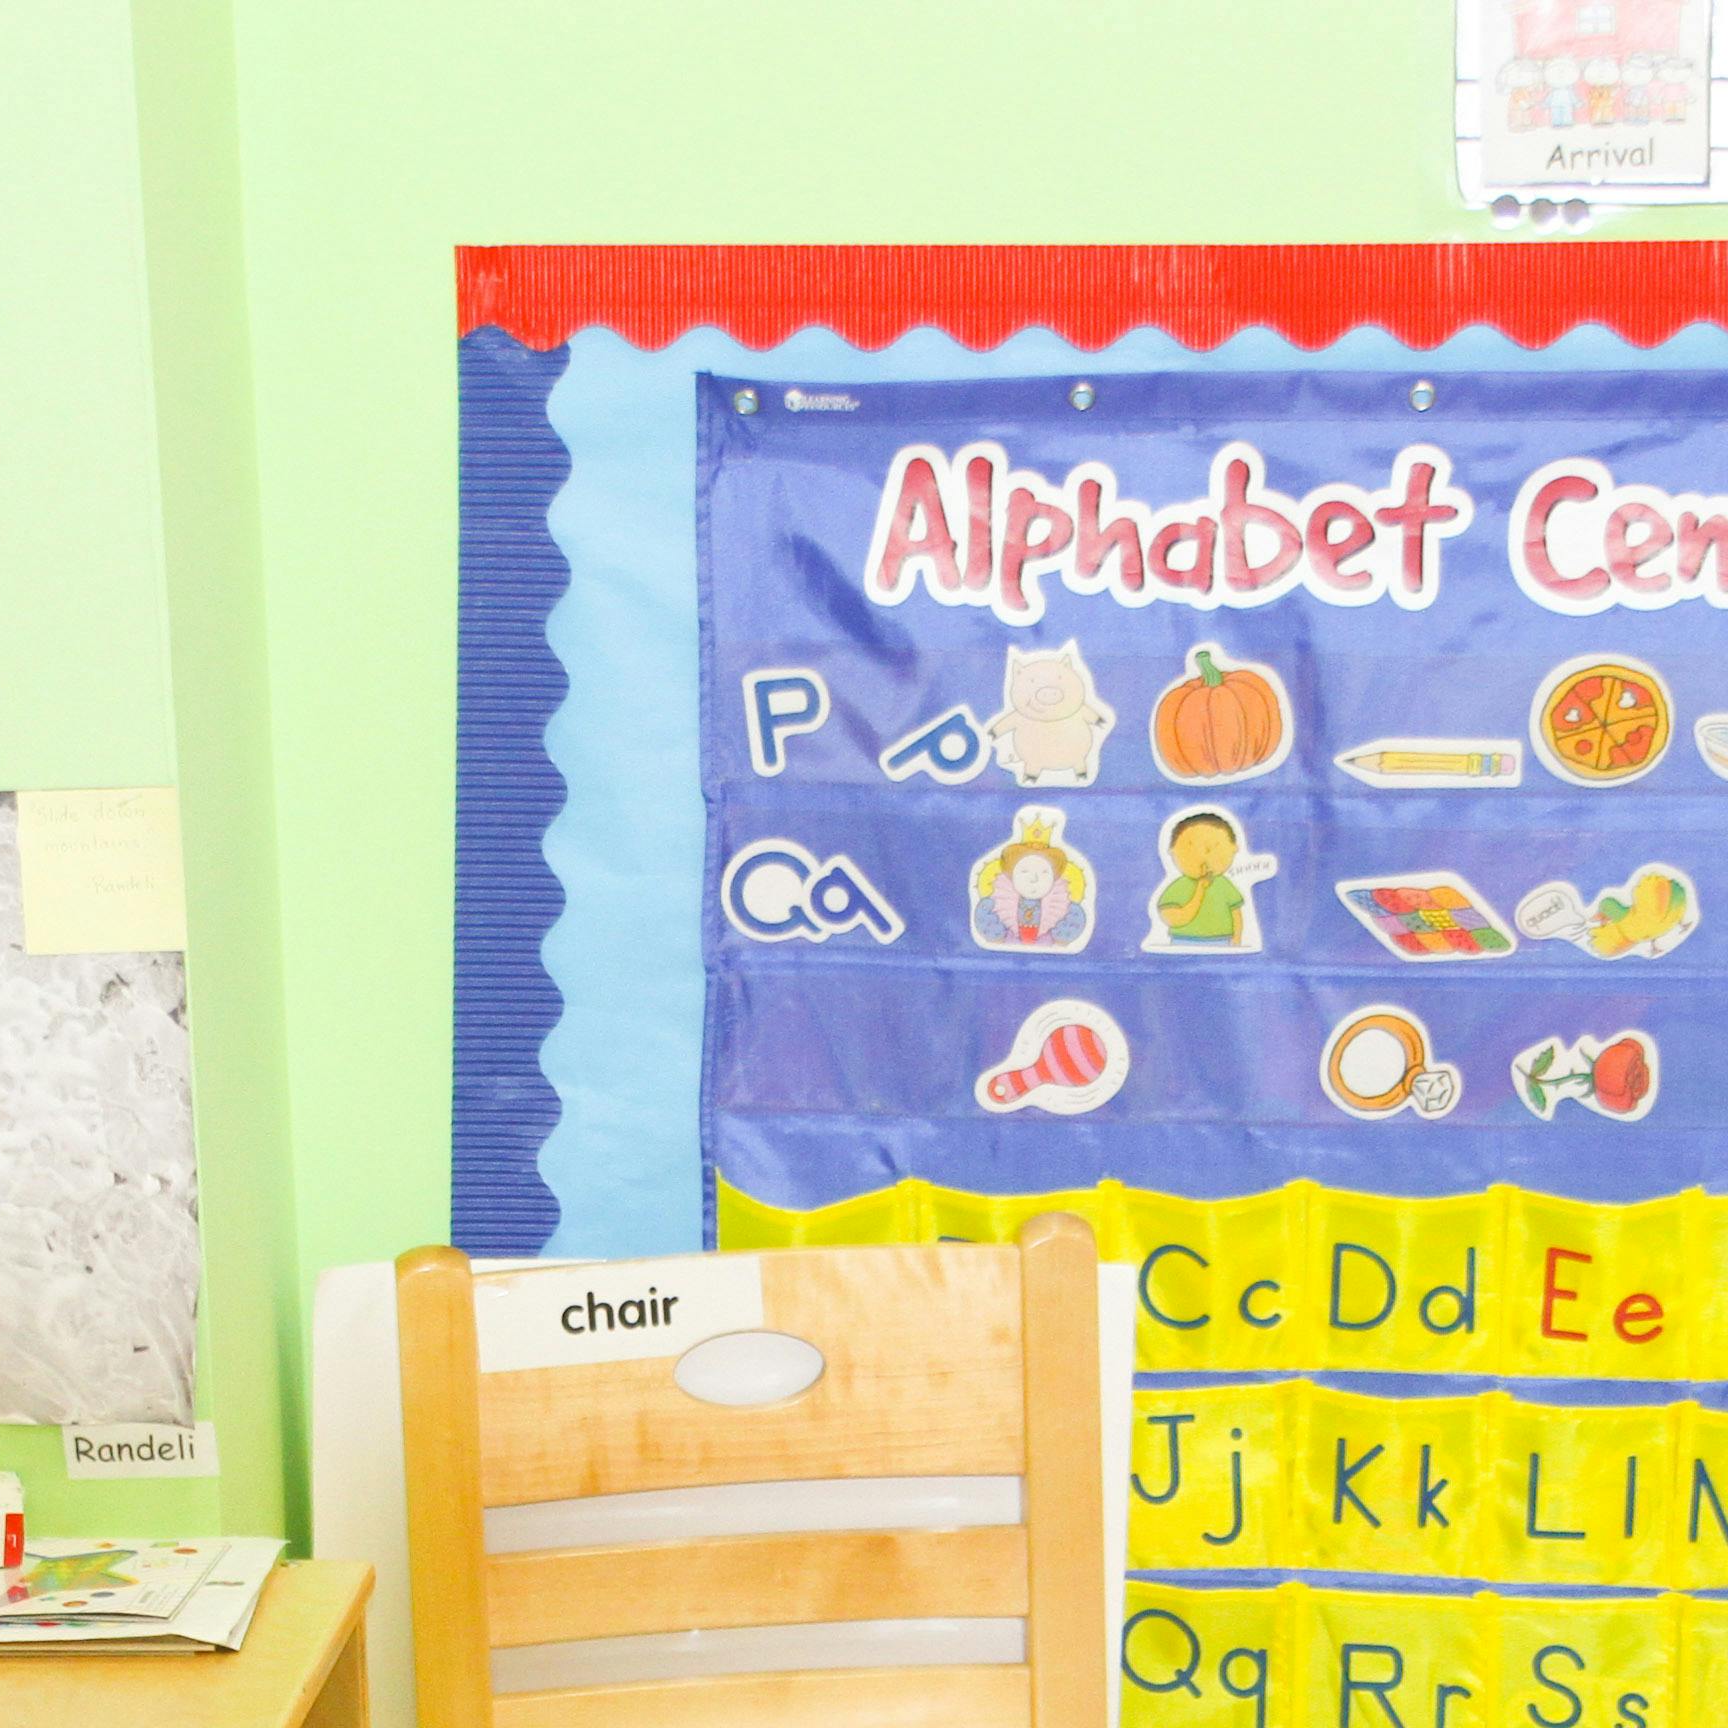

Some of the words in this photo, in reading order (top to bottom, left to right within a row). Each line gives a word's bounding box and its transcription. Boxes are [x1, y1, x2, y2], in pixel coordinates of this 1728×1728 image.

[1546, 138, 1655, 170] Arrival
[872, 450, 1467, 618] Alphabet
[749, 674, 822, 770] P
[561, 1287, 680, 1335] chair
[1139, 1243, 1281, 1329] Cc
[1329, 1243, 1475, 1335] Dd
[1540, 1247, 1664, 1345] Ee
[74, 1434, 195, 1463] Randeli
[1131, 1414, 1243, 1546] Jj
[1335, 1437, 1450, 1529] Kk
[1526, 1452, 1636, 1539] Ll
